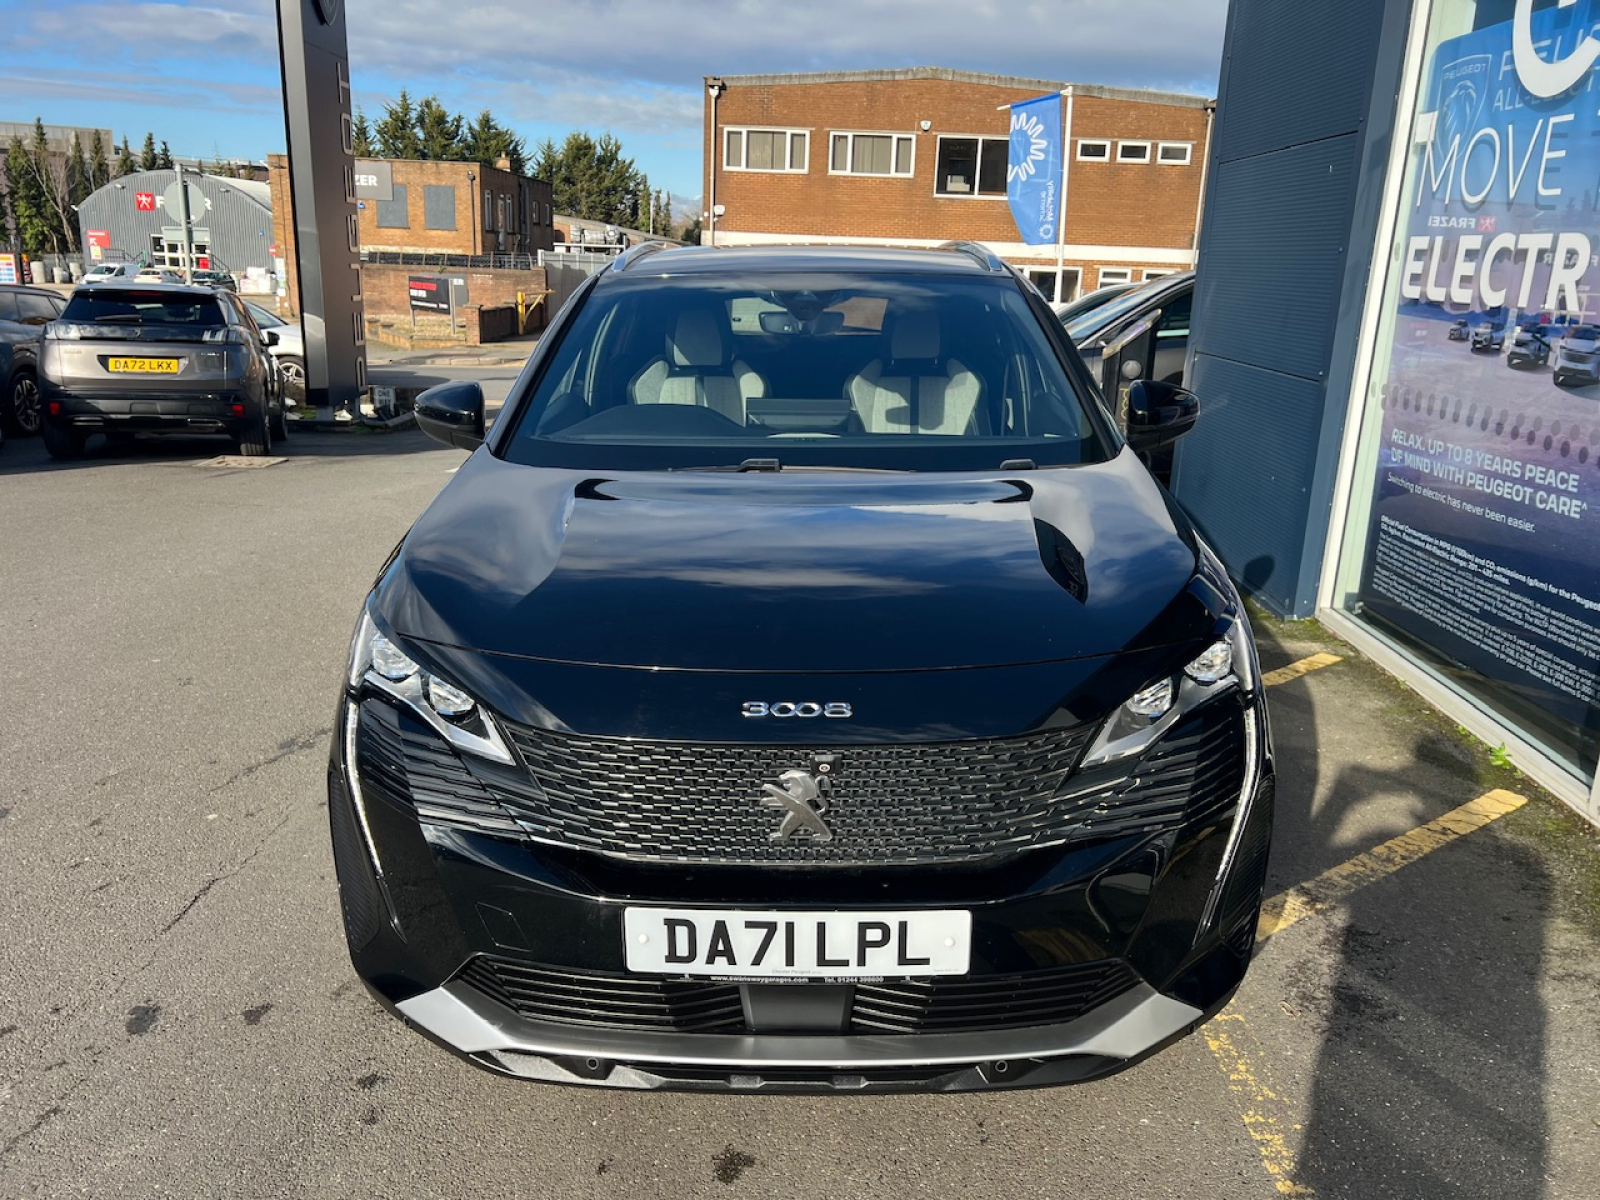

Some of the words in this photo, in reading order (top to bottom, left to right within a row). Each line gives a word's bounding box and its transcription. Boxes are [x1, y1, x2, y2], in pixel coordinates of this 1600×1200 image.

[1444, 63, 1487, 80] PEUGEOT
[1416, 113, 1575, 206] MOVE
[336, 62, 367, 390] PEUGEOT
[1401, 232, 1591, 312] ELECTR
[114, 360, 146, 370] DA72
[149, 360, 172, 371] LKX
[1390, 447, 1404, 463] OF
[1404, 450, 1431, 474] MIND
[1432, 462, 1465, 485] WITH
[1466, 471, 1534, 505] PEUGEOT
[1391, 428, 1426, 451] RELAX.
[1428, 439, 1445, 456] UP
[1447, 443, 1462, 462] TO
[1464, 450, 1473, 465] 8
[1475, 450, 1523, 478] YEARS
[1524, 464, 1580, 492] PEACE
[1414, 485, 1422, 495] to
[1422, 487, 1447, 504] electric
[1446, 494, 1461, 509] has
[1461, 501, 1484, 516] never
[1484, 507, 1506, 523] been
[1507, 517, 1536, 533] easier.
[741, 701, 852, 717] 3008
[663, 918, 795, 967] DA71
[816, 919, 930, 967] LPL
